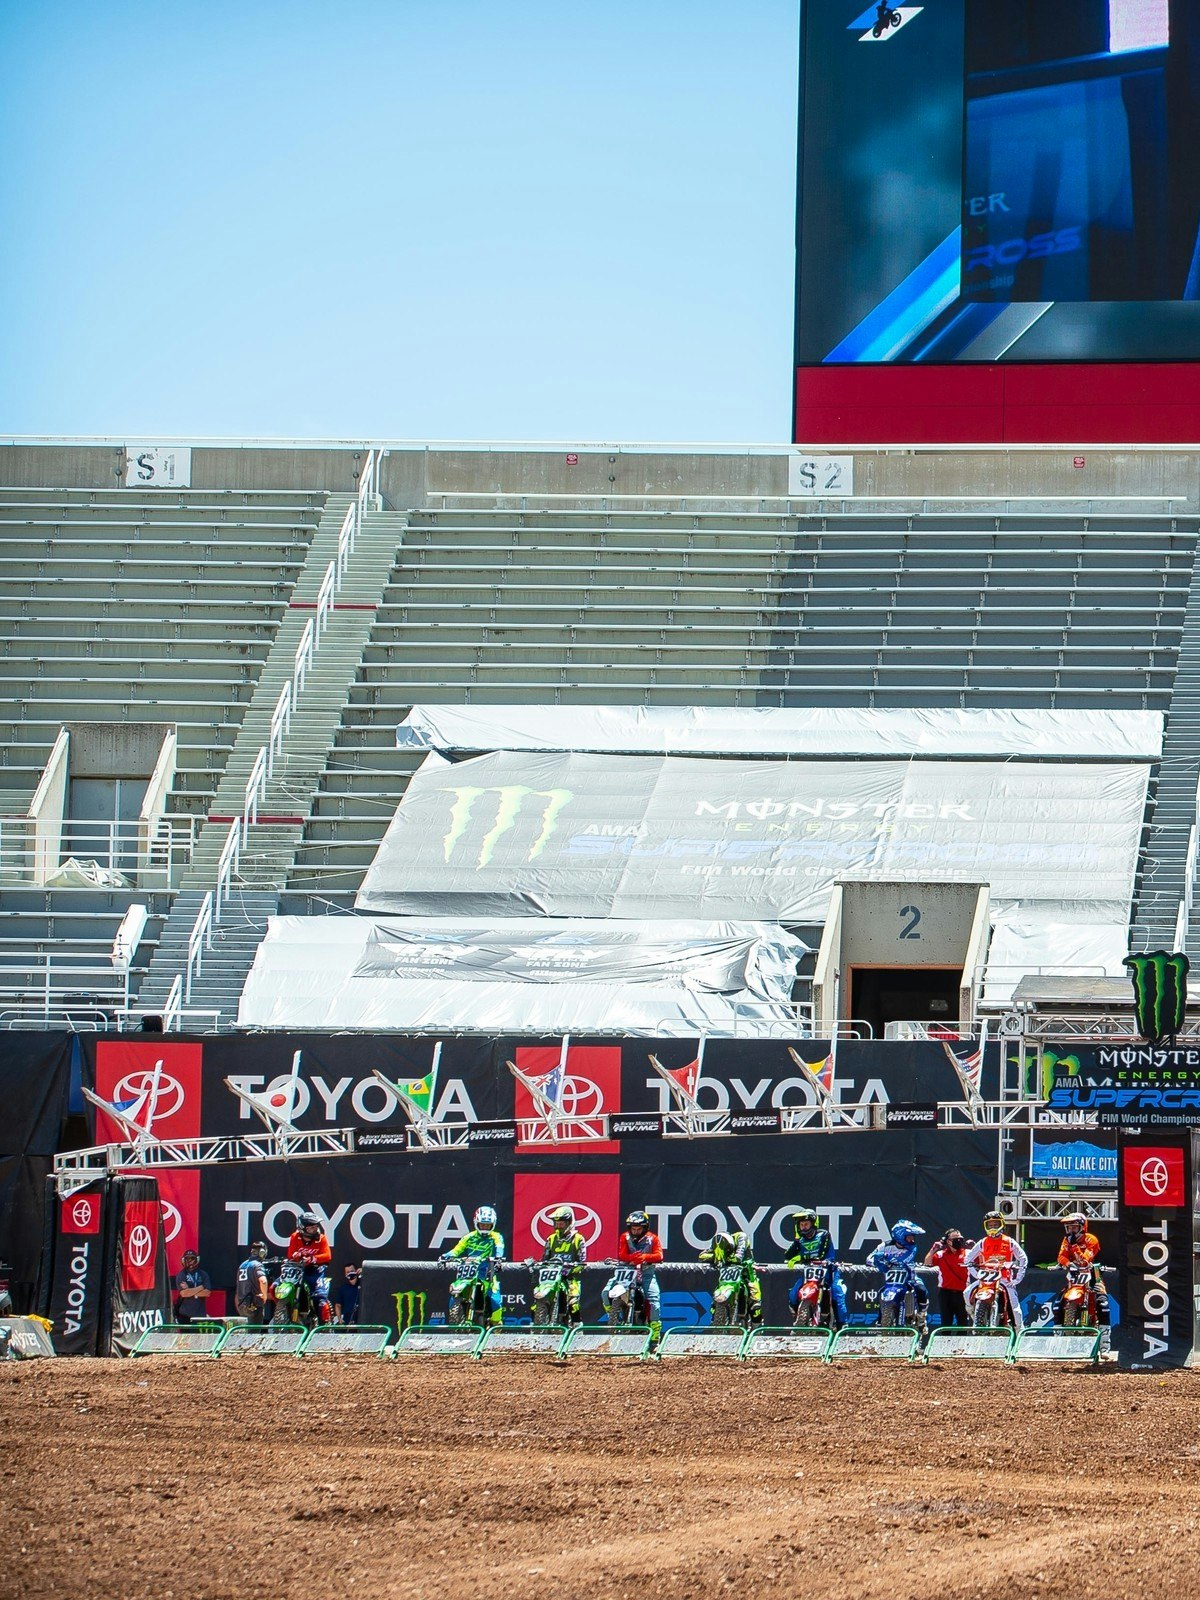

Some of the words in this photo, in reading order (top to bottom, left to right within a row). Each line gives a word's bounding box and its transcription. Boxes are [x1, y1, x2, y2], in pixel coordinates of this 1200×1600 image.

[694, 798, 976, 821] MONSTER
[582, 824, 640, 836] AMA
[680, 865, 724, 876] FIM
[730, 865, 797, 877] World
[899, 905, 921, 940] 2
[1055, 1077, 1080, 1088] AMA
[1101, 1113, 1119, 1123] FIM
[1121, 1113, 1148, 1123] World
[1052, 1156, 1072, 1169] SALT
[1074, 1156, 1095, 1170] LAKE
[1098, 1156, 1118, 1171] CITY
[225, 1201, 472, 1249] TOYOTA
[645, 1204, 894, 1252] TOYOTA
[540, 1270, 559, 1282] 88
[616, 1270, 635, 1281] 114
[720, 1268, 740, 1281] 280
[805, 1268, 825, 1279] 69
[979, 1270, 1001, 1282] 22
[63, 1242, 88, 1336] TOYOTA
[1143, 1219, 1169, 1359] TOYOTA
[118, 1309, 163, 1334] TOYOTA
